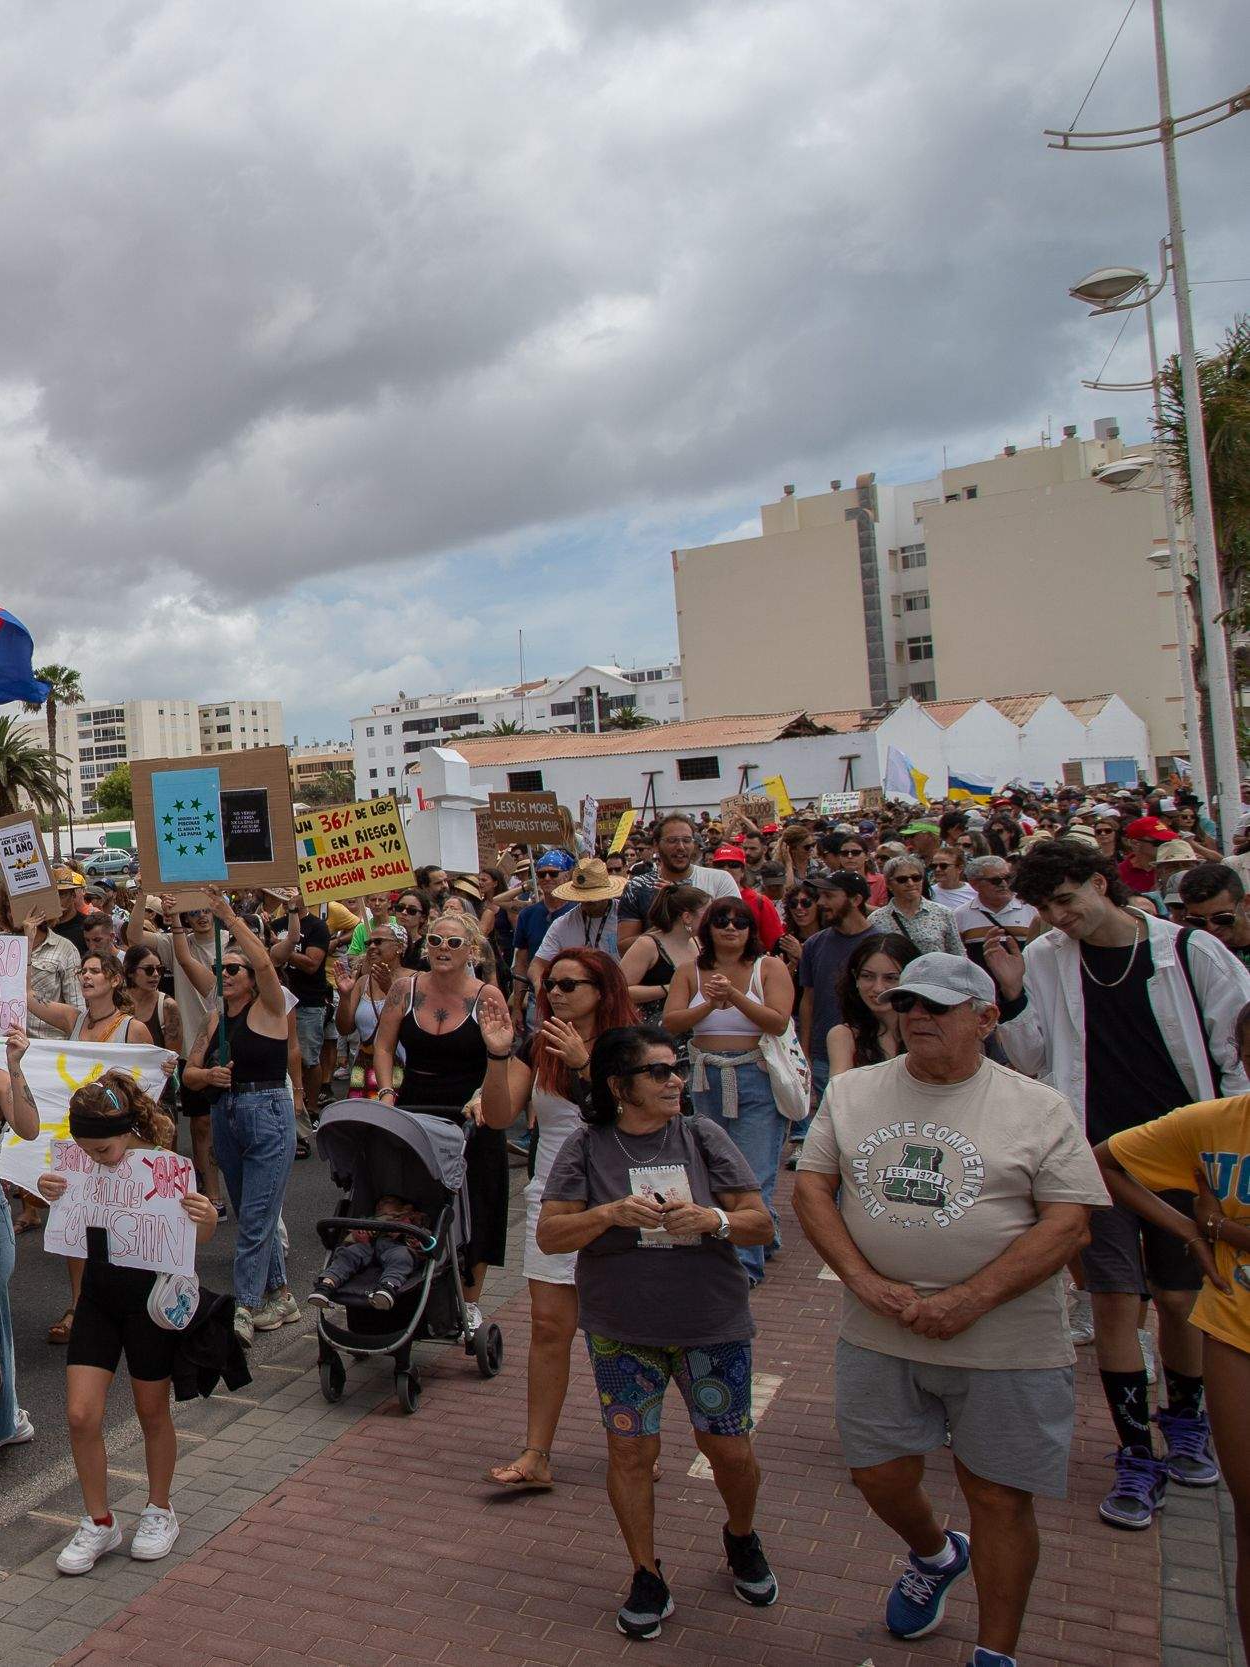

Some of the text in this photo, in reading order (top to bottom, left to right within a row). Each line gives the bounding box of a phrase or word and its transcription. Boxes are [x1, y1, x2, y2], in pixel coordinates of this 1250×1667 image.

[295, 801, 394, 834] UN 36% DE L@S
[494, 802, 516, 814] LESS
[529, 802, 555, 815] MORE
[4, 846, 14, 857] AL
[16, 840, 34, 854] AÑO
[331, 834, 350, 850] EN
[299, 839, 401, 874] DE POBREZA Y/O
[370, 859, 410, 879] SOCIAL
[629, 1165, 685, 1176] EXHIBITION
[852, 1121, 986, 1228] ALPHA STATE COMPETITORS
[891, 1168, 939, 1184] EST. 1974
[83, 1175, 143, 1209] FUTURO
